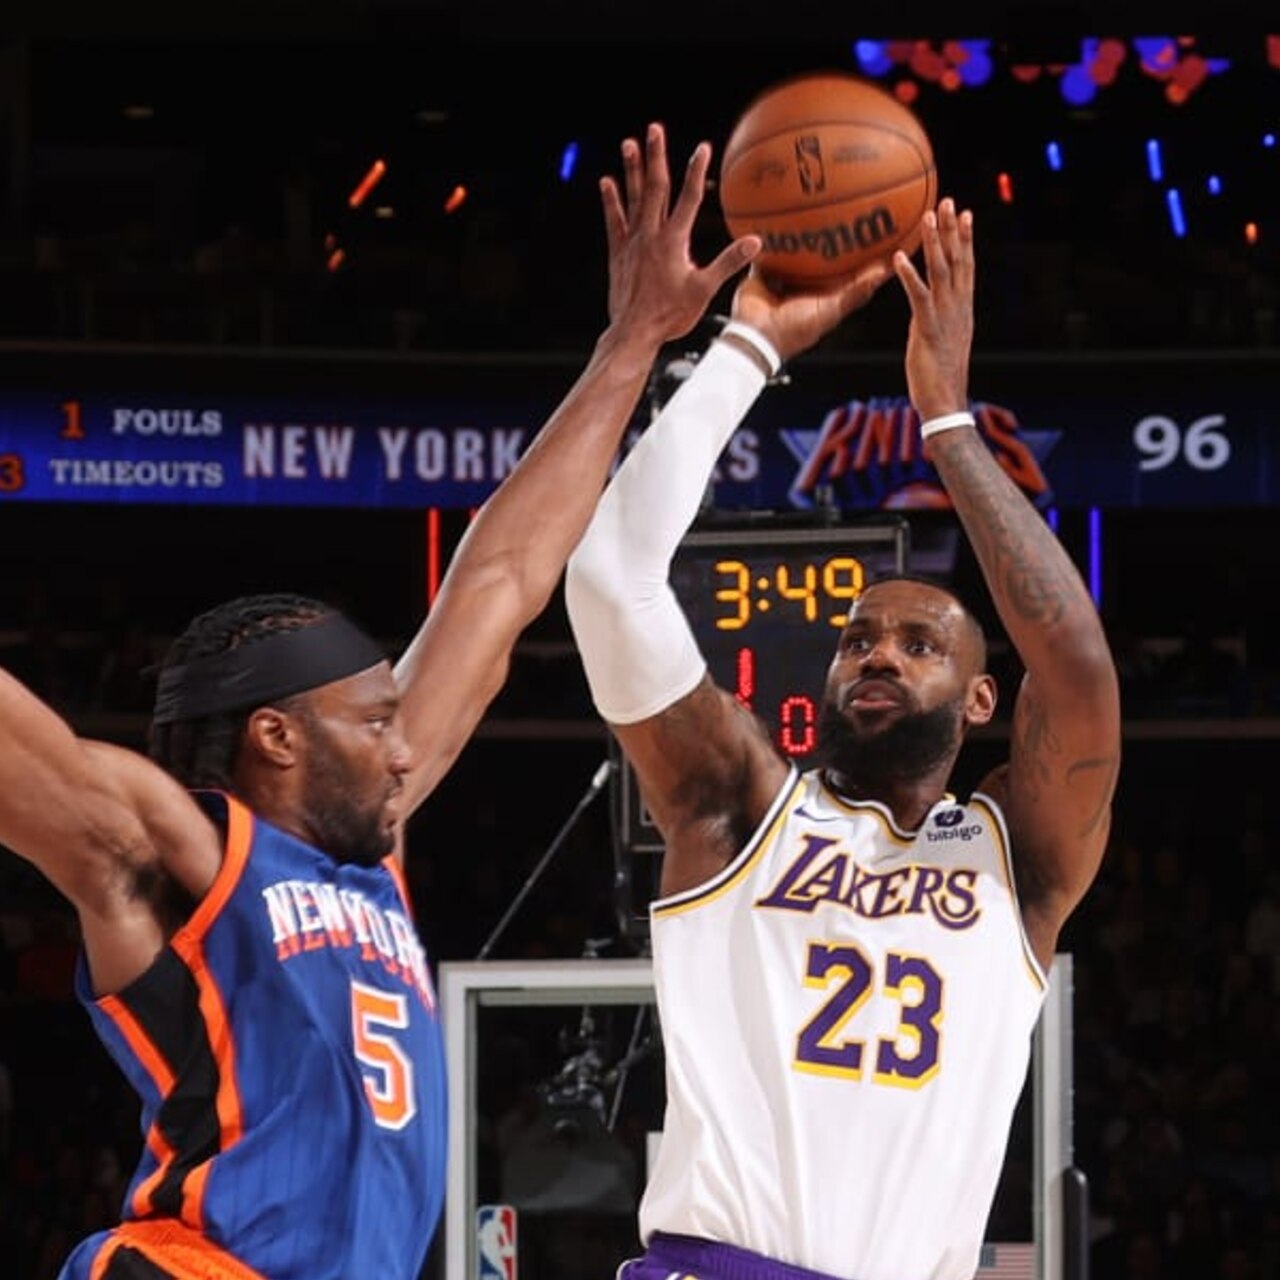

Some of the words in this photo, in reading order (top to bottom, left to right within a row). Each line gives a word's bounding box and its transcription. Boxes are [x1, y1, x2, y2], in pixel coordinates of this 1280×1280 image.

[62, 401, 84, 439] 1
[112, 408, 223, 436] FOULS
[1133, 415, 1231, 471] 96
[48, 459, 225, 487] TIMEOUTS
[243, 426, 354, 479] NEW
[378, 428, 522, 481] YORK
[792, 400, 1050, 506] KNIS
[715, 557, 864, 630] 3:49
[781, 696, 815, 754] 0
[926, 824, 983, 843] bibigo
[756, 832, 982, 931] LAKERS
[262, 878, 353, 962] NEW
[791, 939, 943, 1092] 23
[350, 979, 417, 1132] 5
